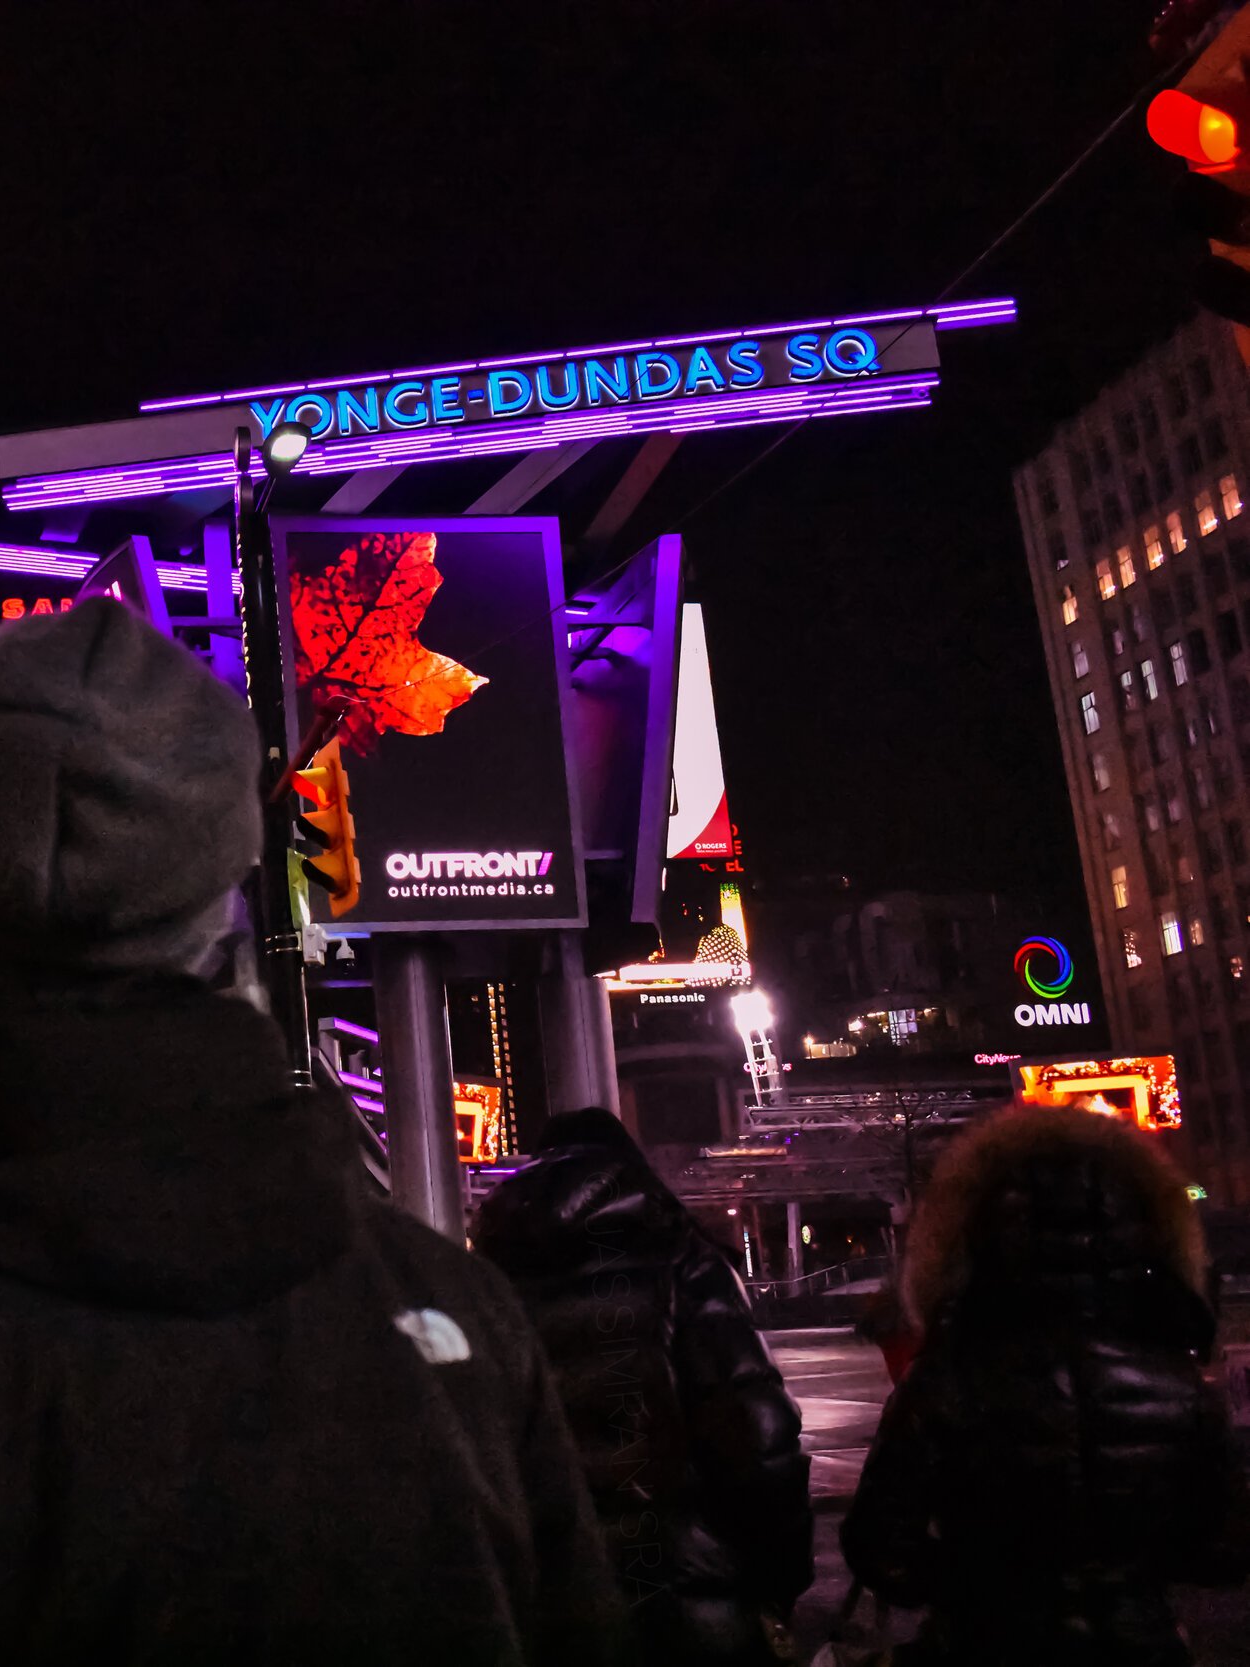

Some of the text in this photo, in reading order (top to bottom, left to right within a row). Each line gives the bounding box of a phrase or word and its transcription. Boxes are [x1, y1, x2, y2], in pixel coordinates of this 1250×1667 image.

[786, 327, 883, 381] SQ
[701, 842, 727, 850] ROGERS
[388, 882, 554, 897] outfrontmedia.ca
[640, 992, 706, 1004] Panasonic
[1014, 1003, 1090, 1027] OMNI
